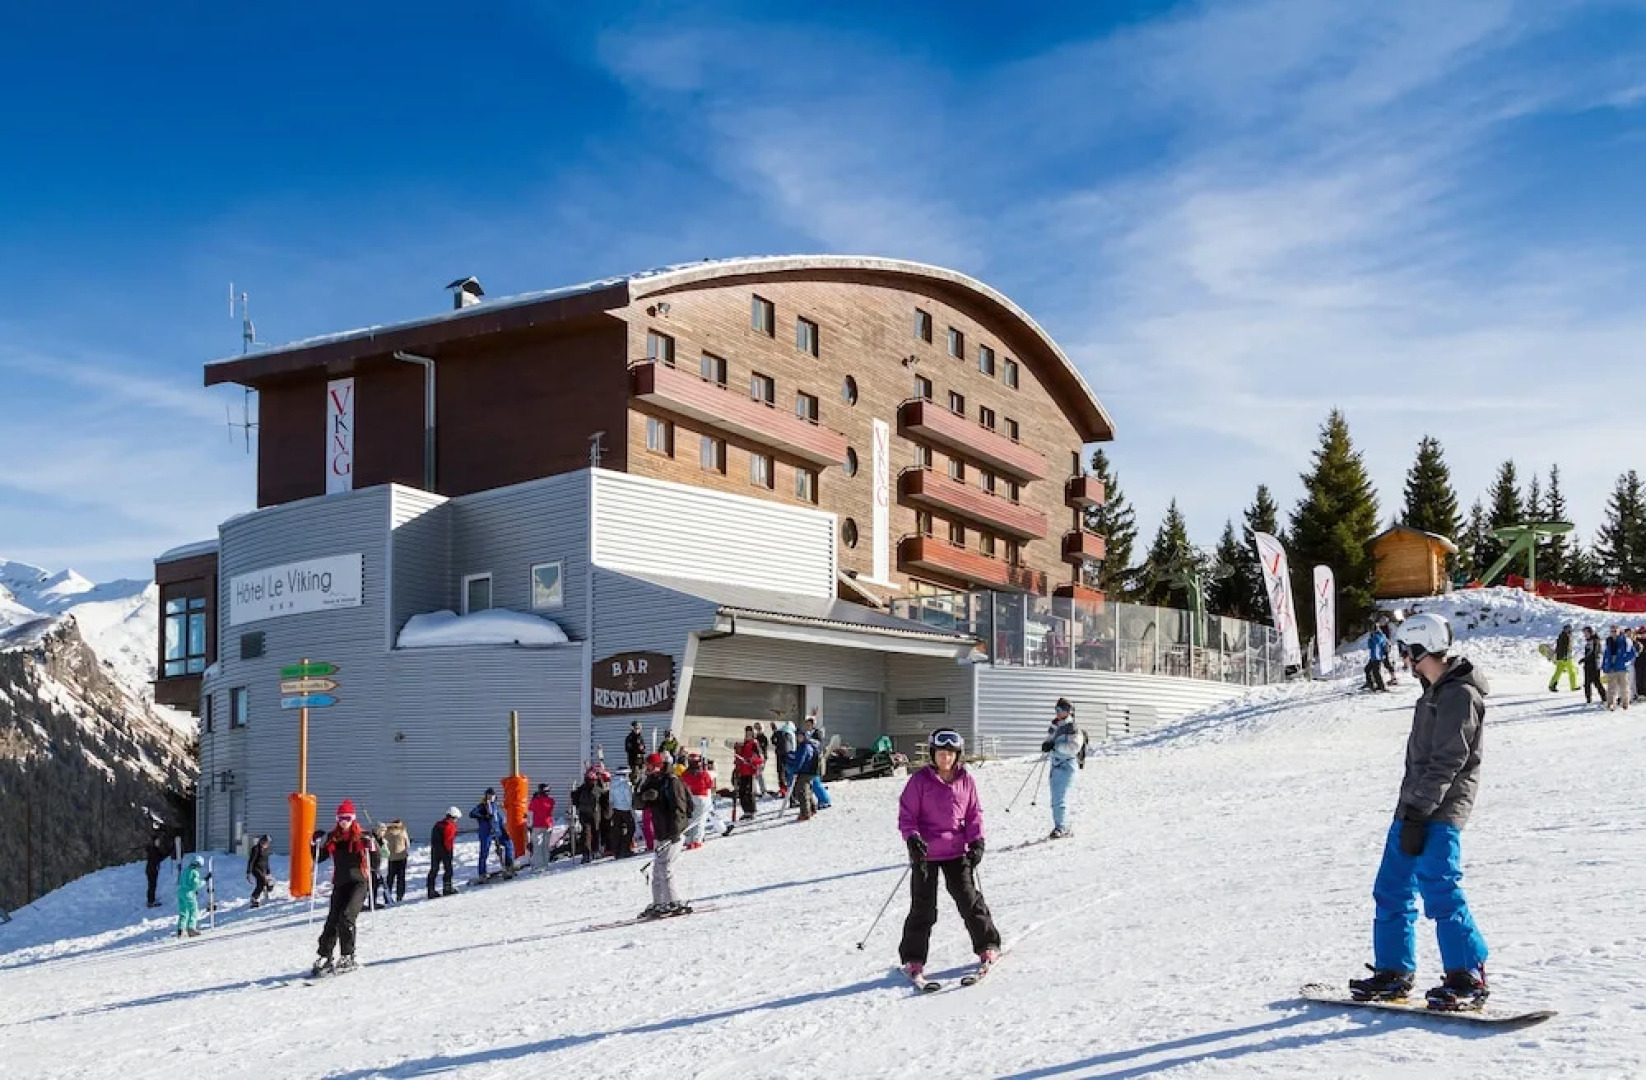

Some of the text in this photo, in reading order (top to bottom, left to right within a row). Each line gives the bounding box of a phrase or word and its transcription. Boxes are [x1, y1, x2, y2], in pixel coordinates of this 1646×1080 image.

[236, 570, 332, 605] Hôtel Le Viking
[611, 659, 648, 677] BAR
[593, 679, 671, 709] RESTAURANT
